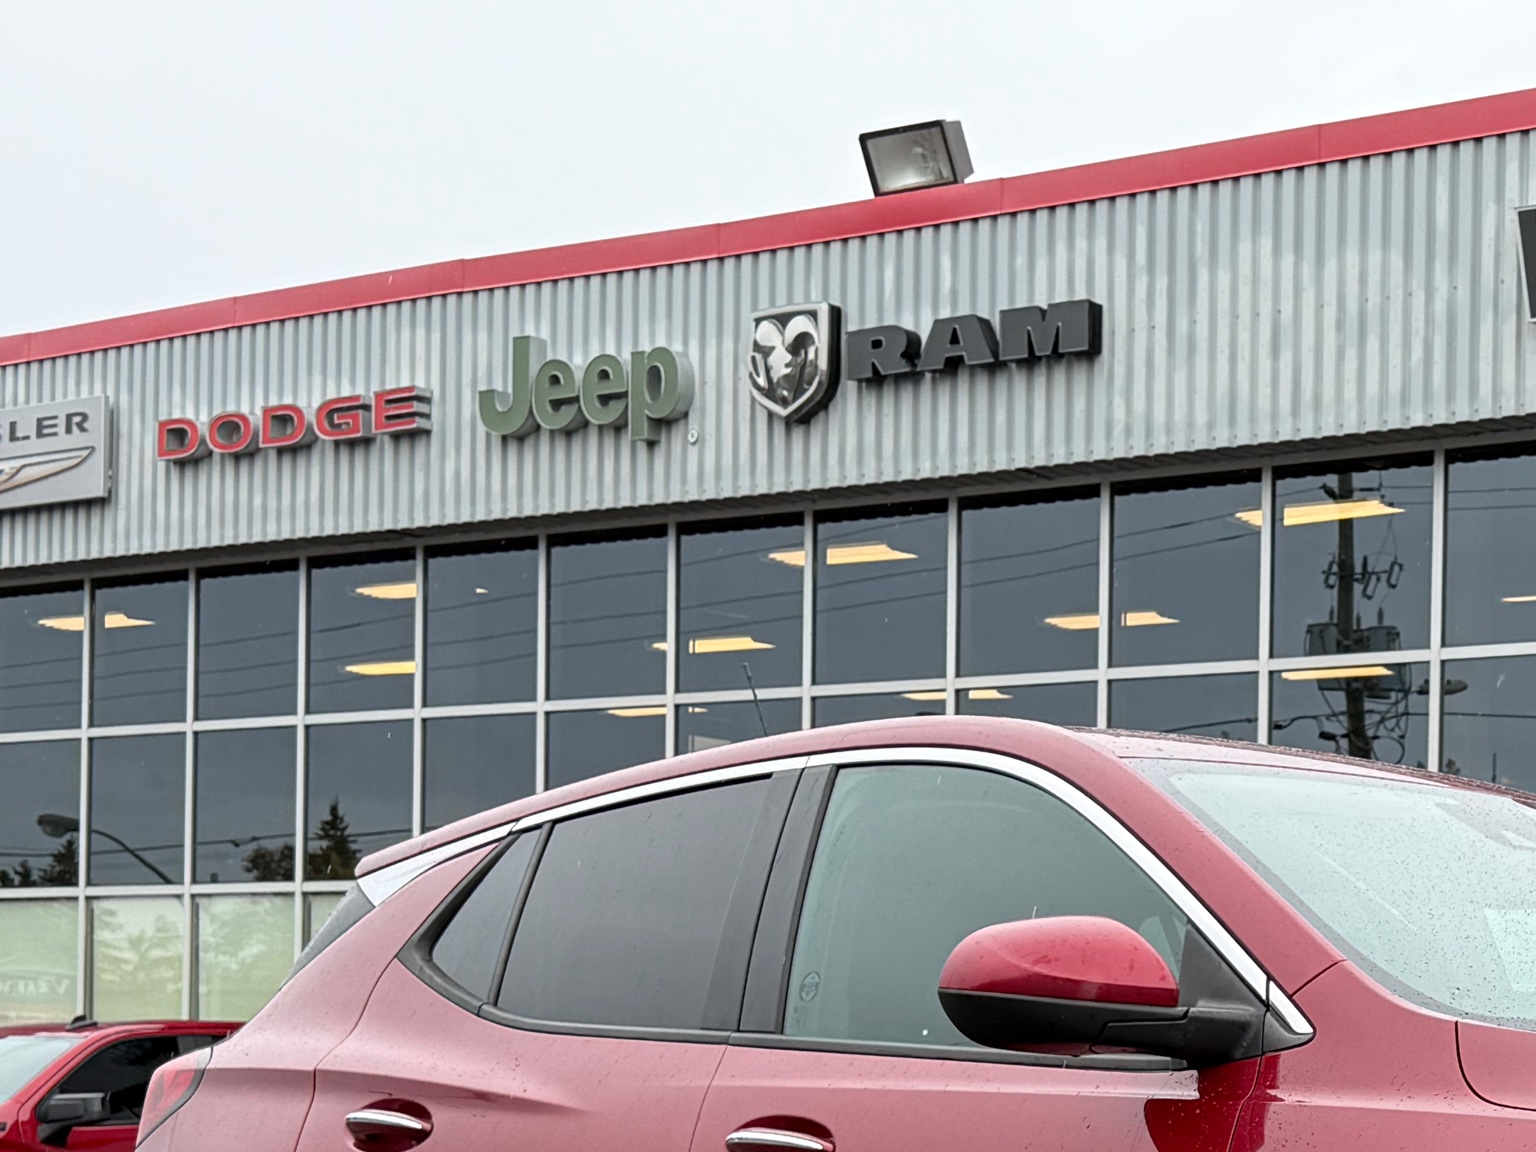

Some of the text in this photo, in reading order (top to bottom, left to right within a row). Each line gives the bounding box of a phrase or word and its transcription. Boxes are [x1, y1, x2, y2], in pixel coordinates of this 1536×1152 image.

[846, 298, 1103, 384] RAM
[0, 411, 90, 444] LER
[156, 384, 432, 462] DODGE
[478, 334, 695, 442] Jeep
